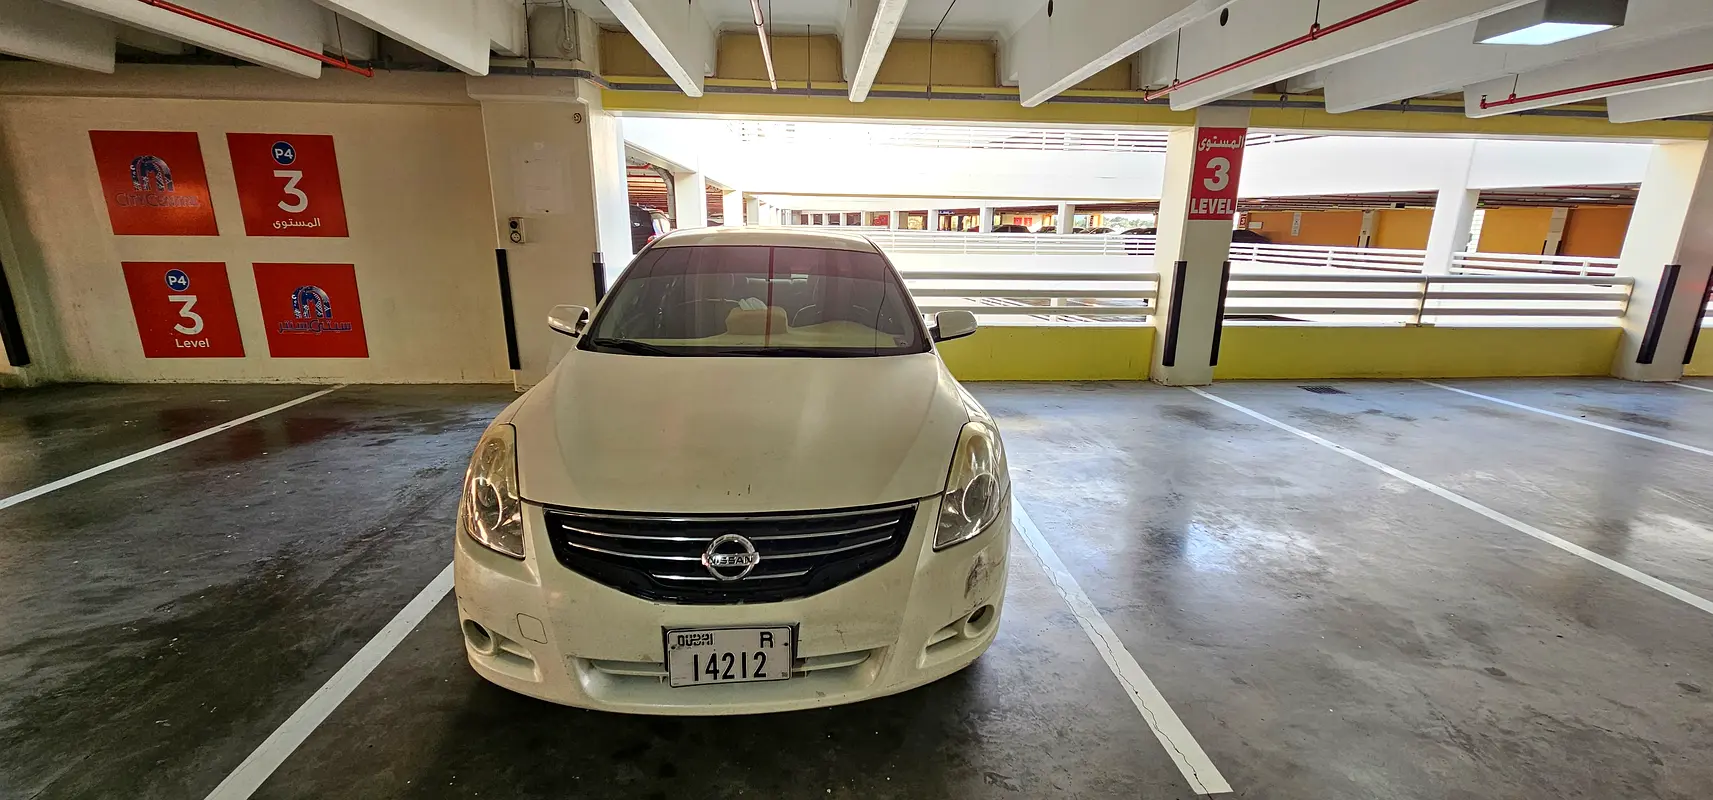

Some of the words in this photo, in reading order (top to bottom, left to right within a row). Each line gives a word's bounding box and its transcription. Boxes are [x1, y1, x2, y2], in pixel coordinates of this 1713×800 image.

[1198, 135, 1245, 151] المستوى
[274, 148, 293, 159] P4
[1204, 157, 1230, 191] 3
[273, 170, 308, 213] 3
[1190, 198, 1234, 214] LEVEL
[272, 217, 321, 229] المستوى
[168, 275, 187, 286] P4
[168, 295, 204, 335] 3
[175, 338, 210, 348] Level
[708, 556, 753, 565] NISSAN
[759, 631, 773, 648] R
[693, 651, 767, 681] 14212
